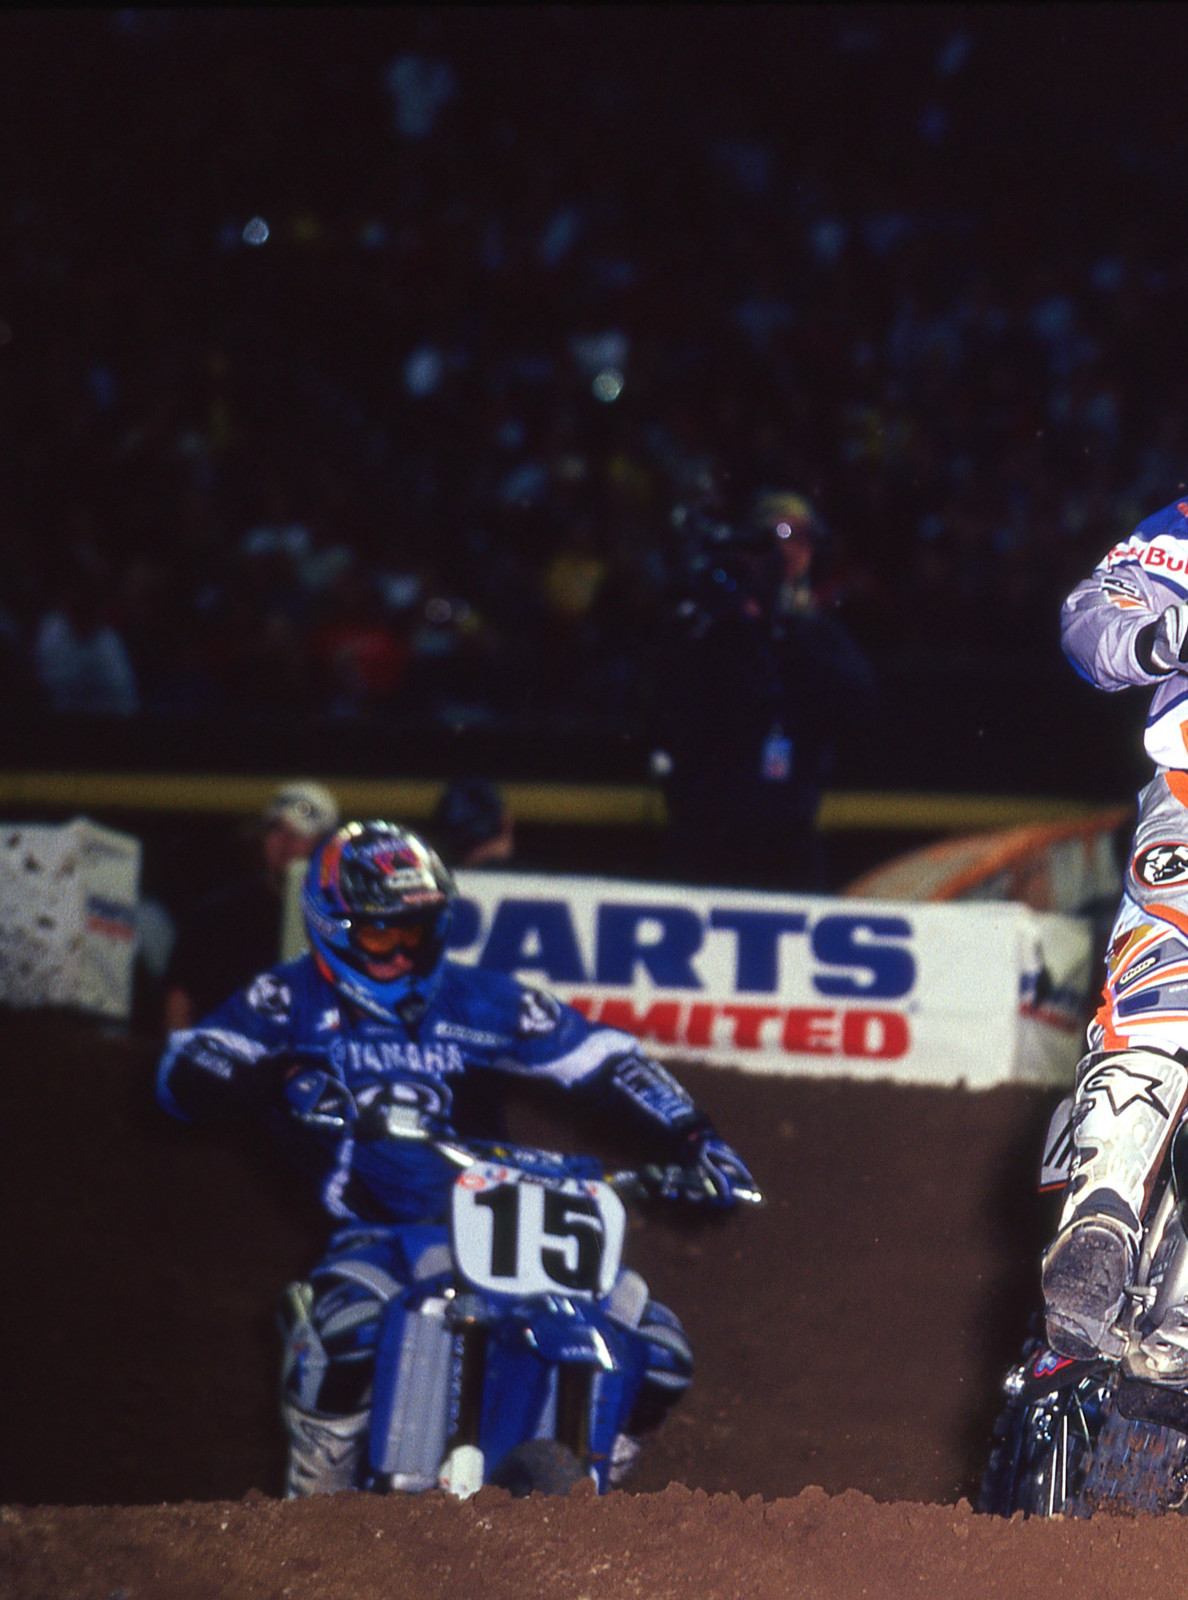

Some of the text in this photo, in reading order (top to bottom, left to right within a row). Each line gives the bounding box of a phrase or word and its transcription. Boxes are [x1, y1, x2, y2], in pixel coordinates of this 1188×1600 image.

[346, 1041, 466, 1074] YAMAHA
[571, 997, 909, 1059] MITED
[474, 1184, 603, 1292] 15
